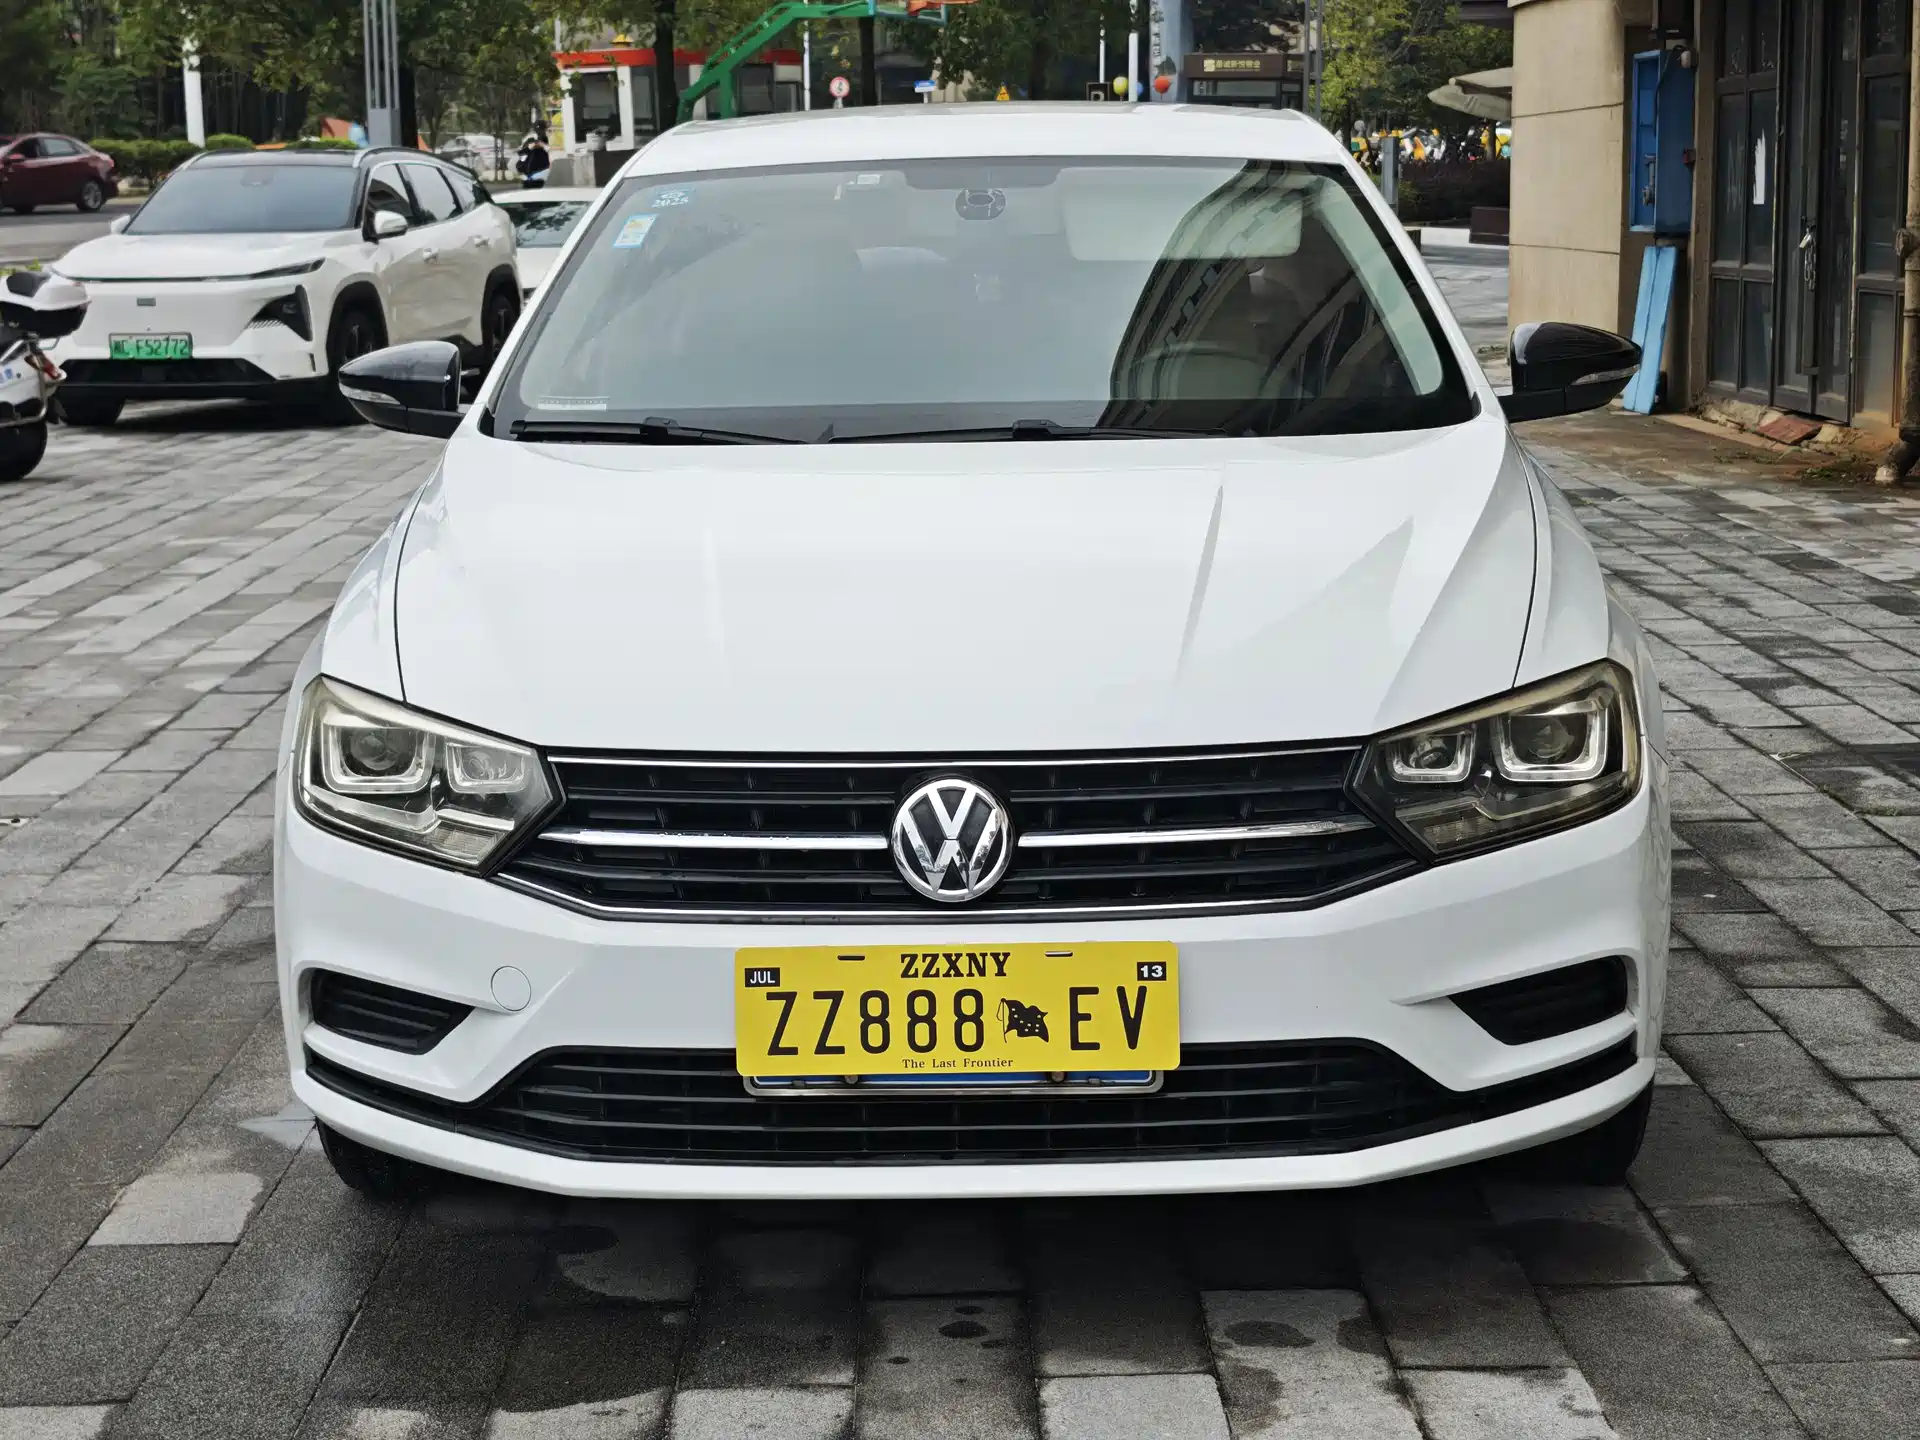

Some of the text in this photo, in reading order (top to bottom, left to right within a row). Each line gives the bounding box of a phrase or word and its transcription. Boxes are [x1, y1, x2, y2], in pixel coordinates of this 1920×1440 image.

[900, 952, 1011, 979] ZZXNY
[1140, 965, 1164, 979] 13
[749, 970, 776, 985] JUL
[766, 985, 1148, 1057] ZZ888 EV
[902, 1058, 1014, 1069] The Last Frontier
